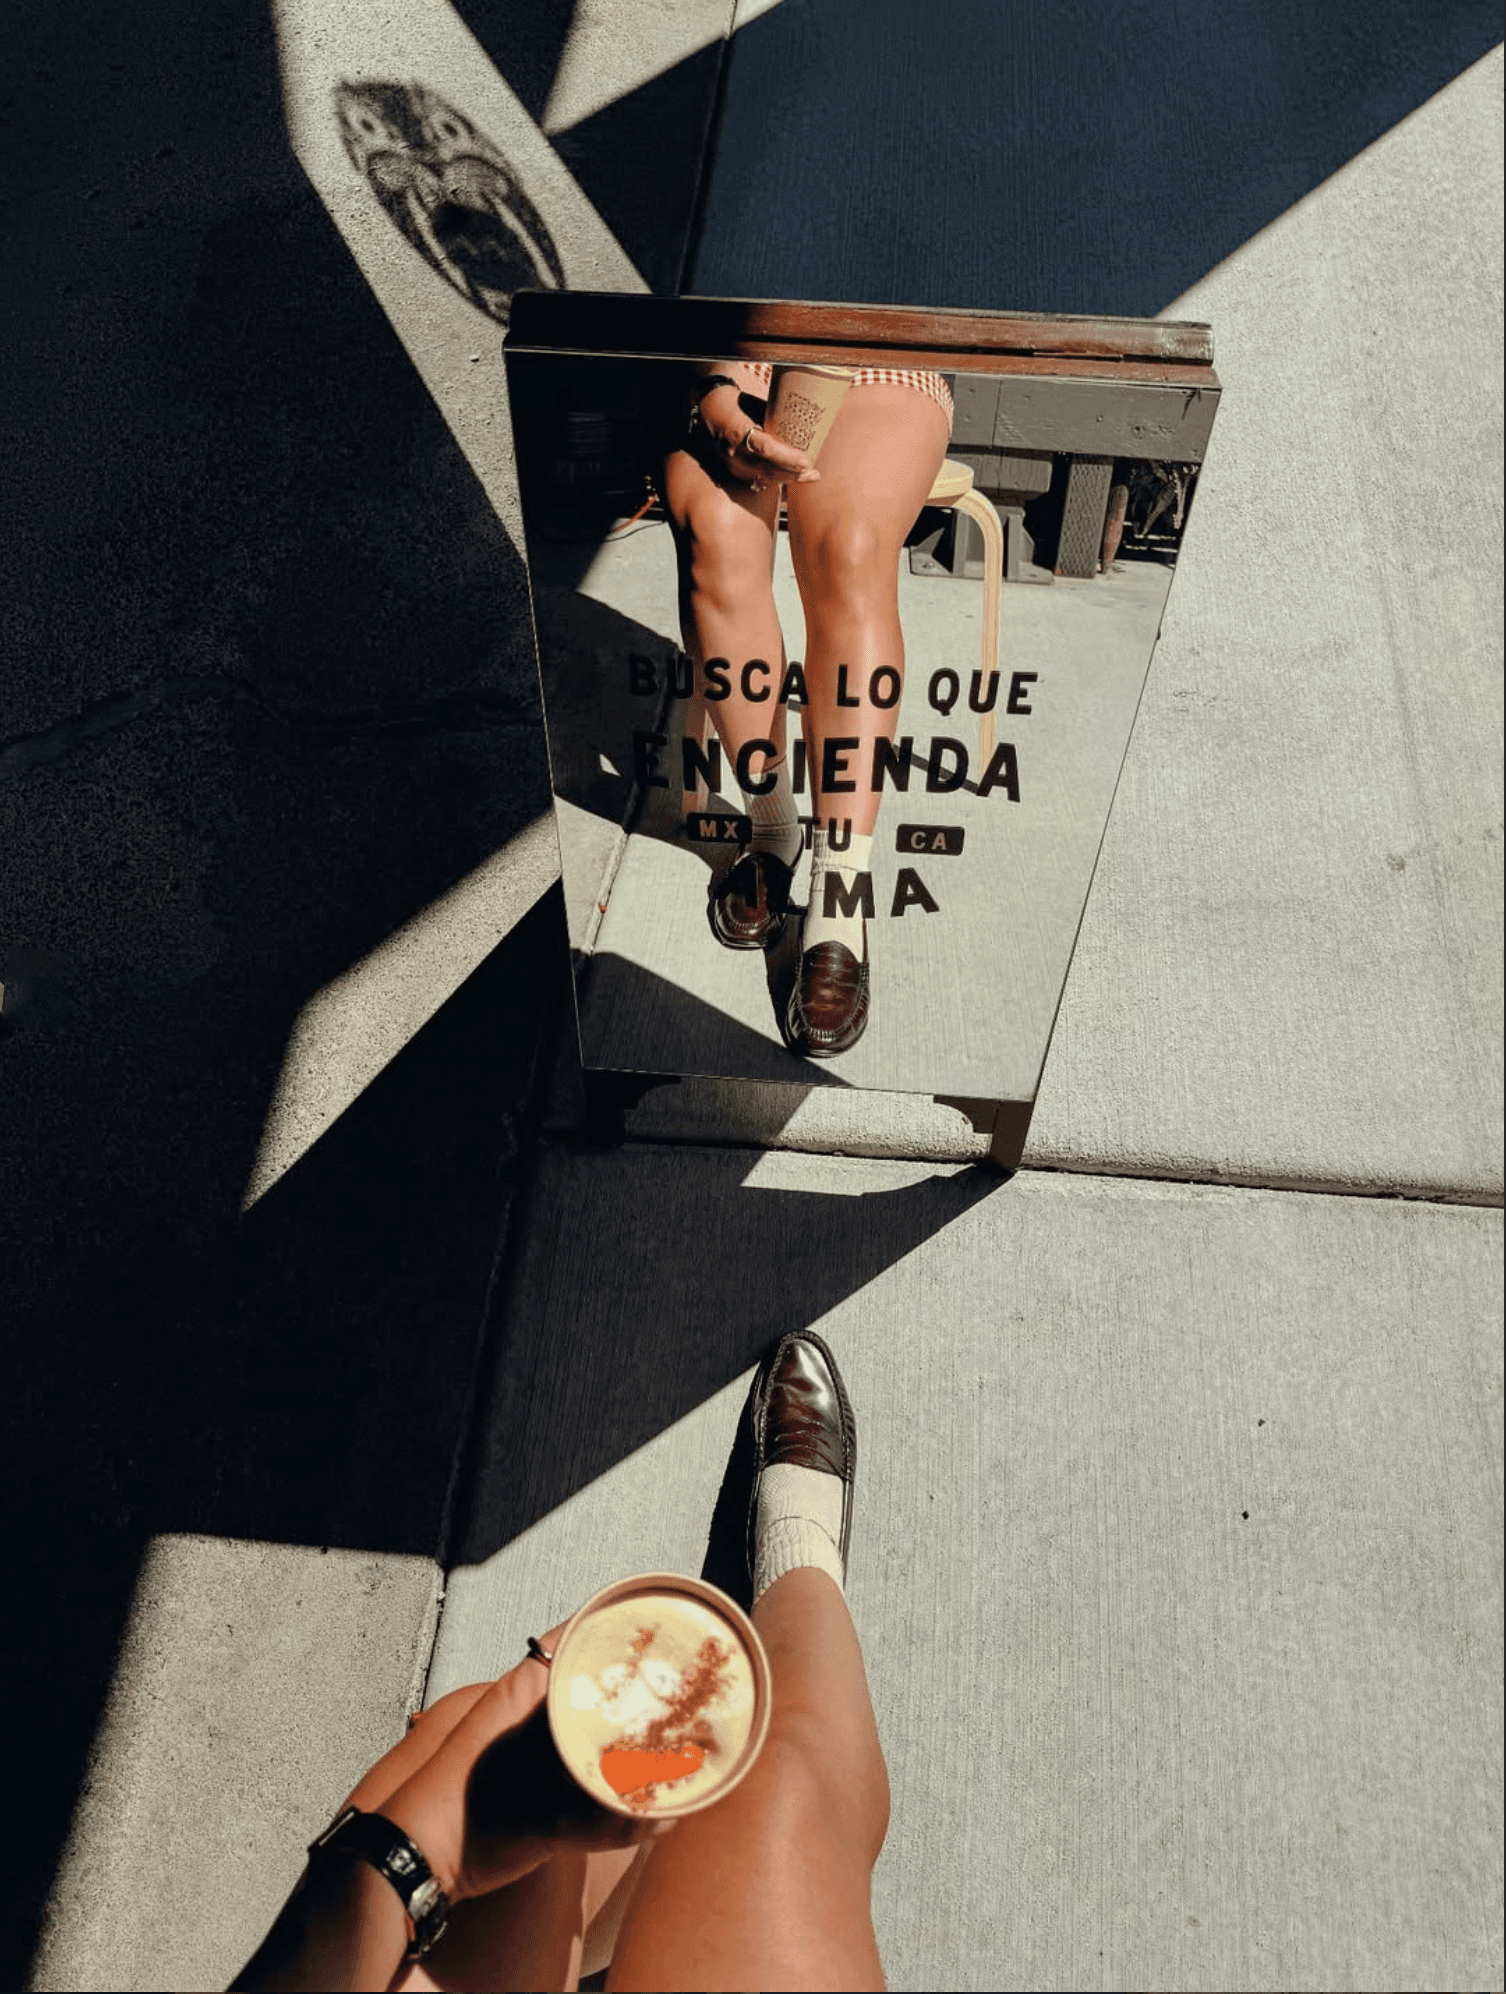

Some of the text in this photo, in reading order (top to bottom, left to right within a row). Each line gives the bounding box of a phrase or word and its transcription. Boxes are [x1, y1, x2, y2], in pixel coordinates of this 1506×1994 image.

[629, 653, 1039, 716] BUSCA LO QUE
[632, 730, 1021, 803] ENCIENDA
[699, 815, 948, 852] MX TU CA
